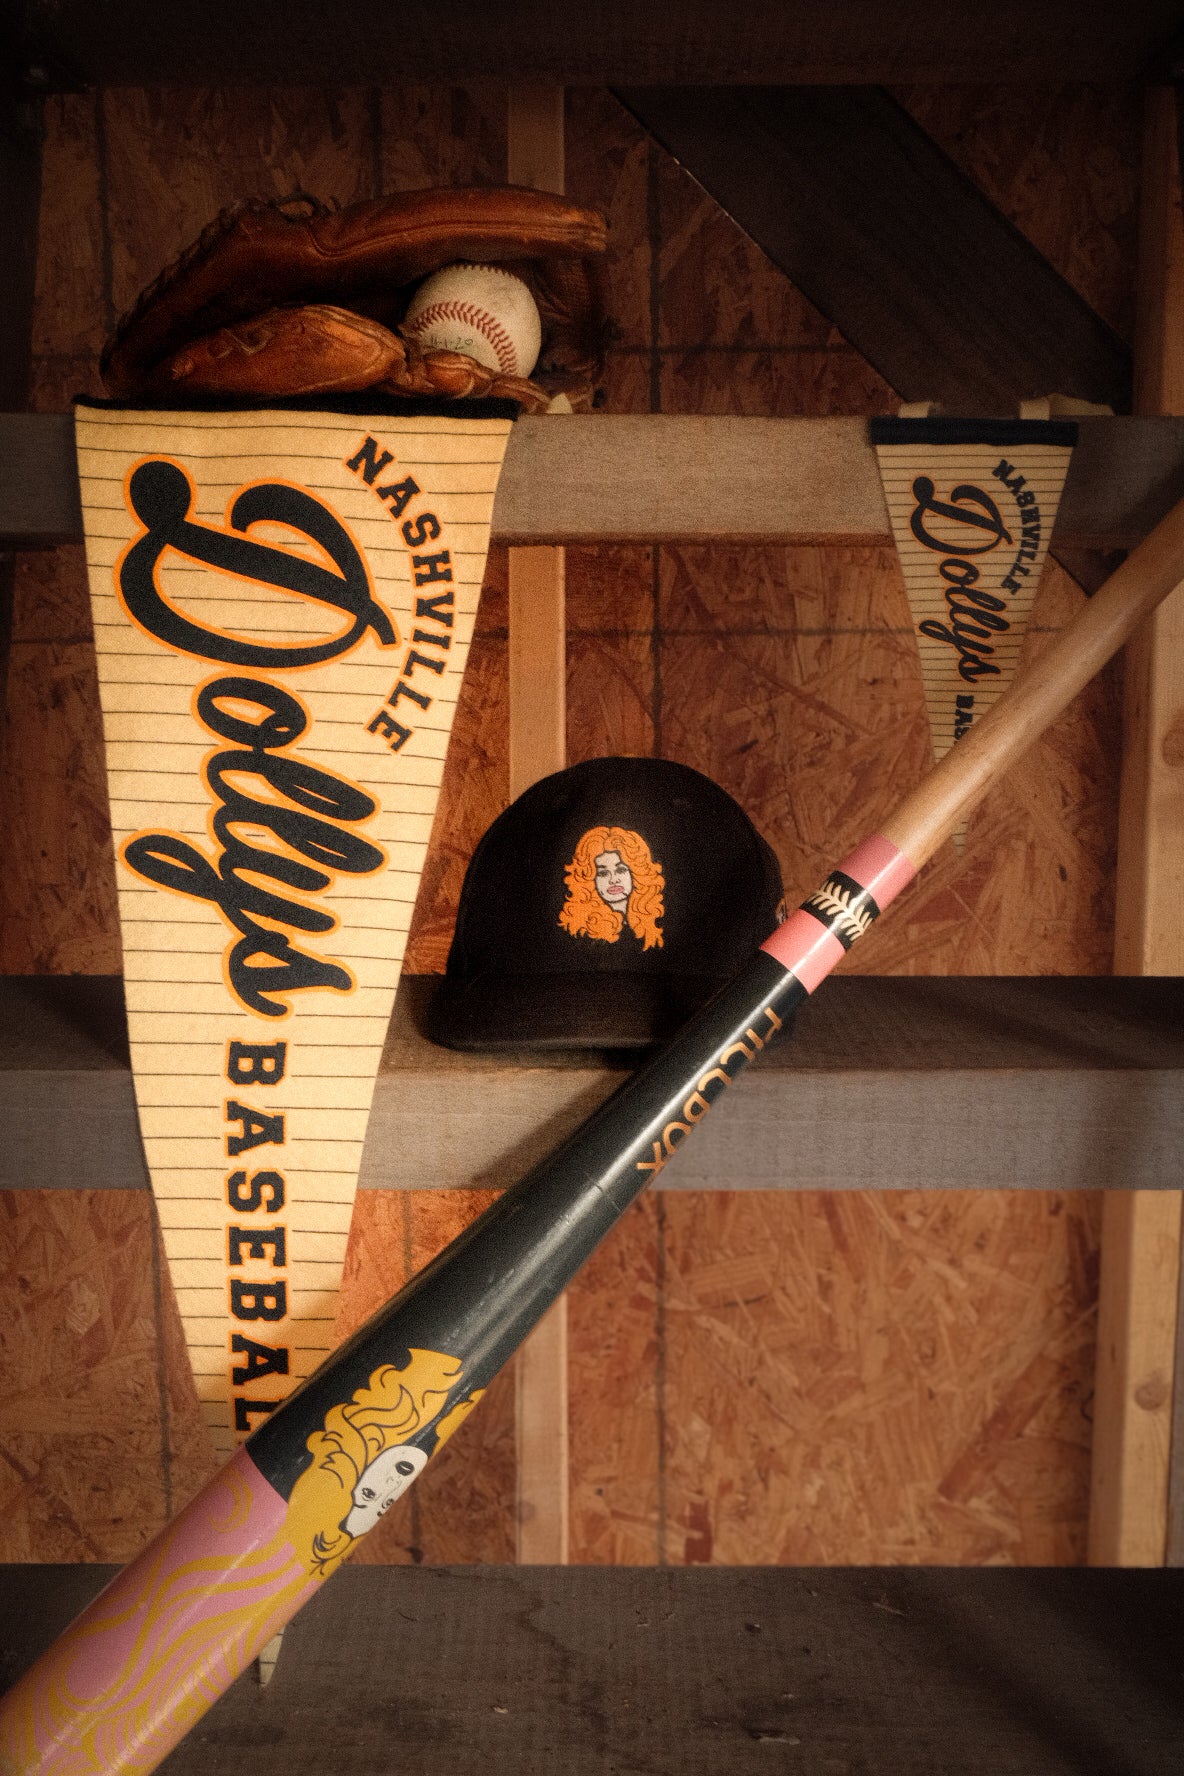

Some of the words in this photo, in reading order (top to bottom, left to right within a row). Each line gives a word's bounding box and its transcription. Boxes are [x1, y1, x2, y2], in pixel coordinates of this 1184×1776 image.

[344, 433, 455, 752] NASHVILLE
[910, 476, 1013, 684] Dollys
[992, 459, 1041, 595] NASHVILLE
[115, 455, 400, 1019] Dollys
